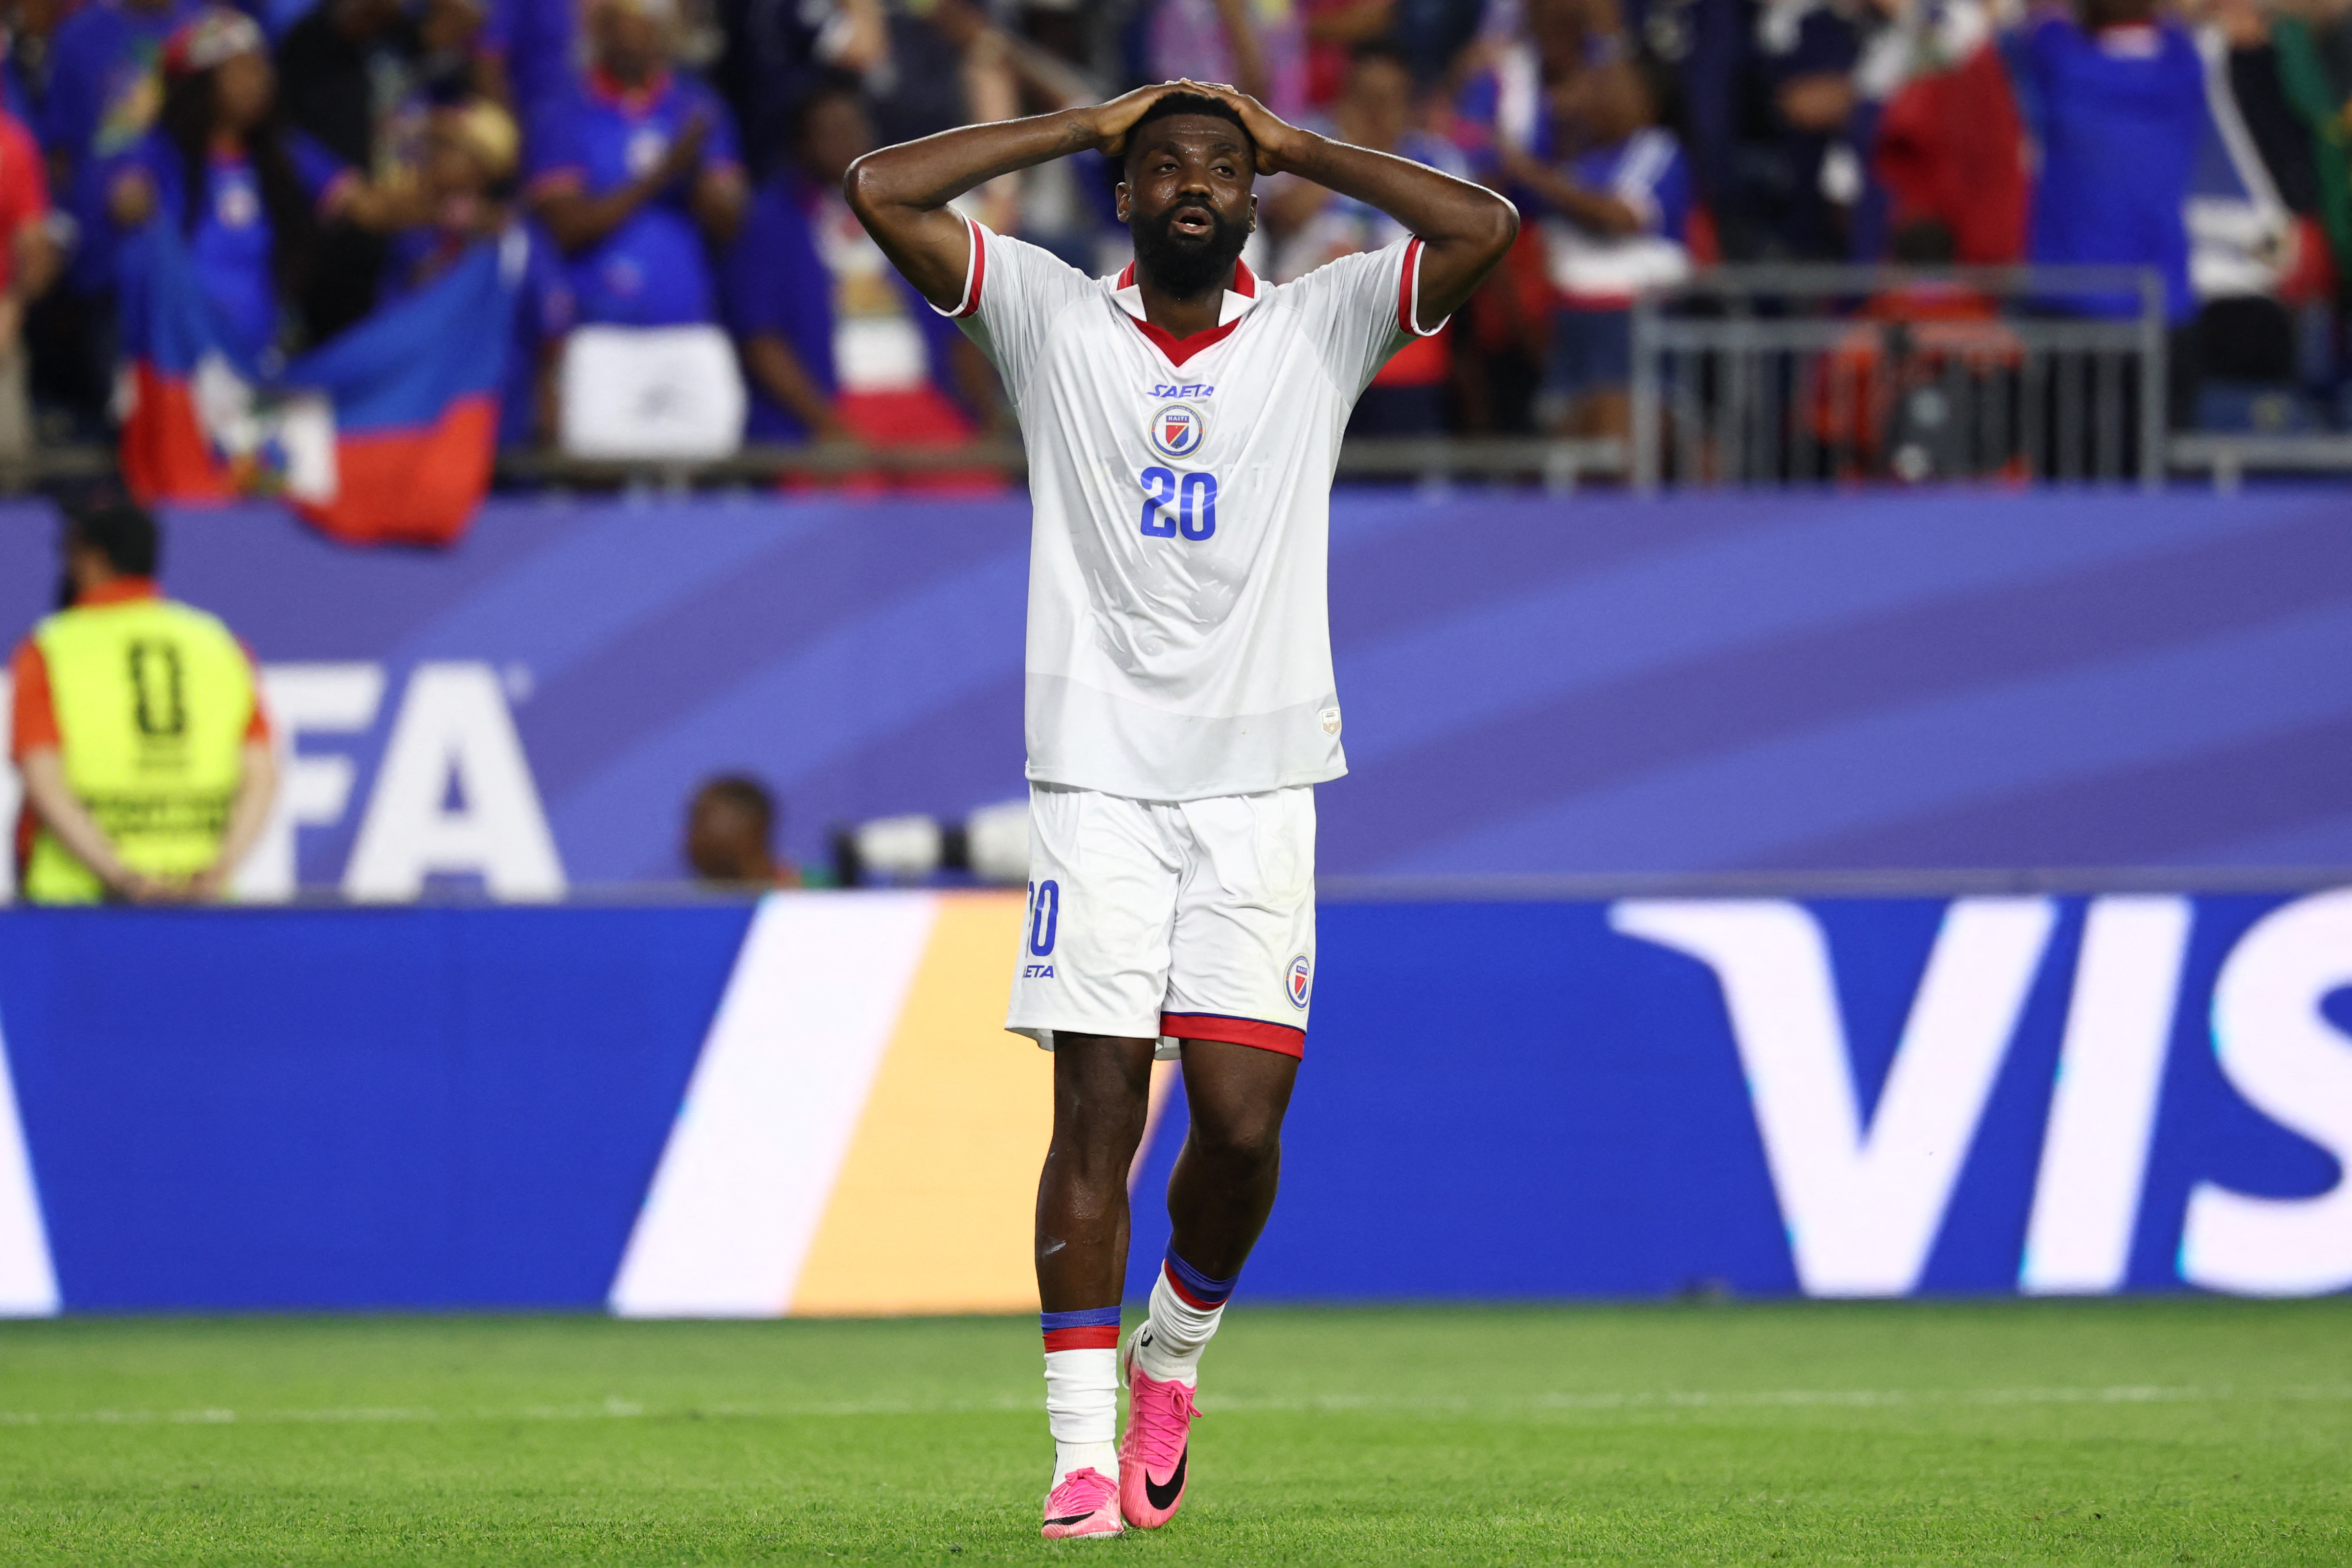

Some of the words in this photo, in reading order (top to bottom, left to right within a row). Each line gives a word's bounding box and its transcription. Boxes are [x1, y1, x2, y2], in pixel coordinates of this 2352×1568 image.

[1146, 384, 1214, 398] SAETA
[1140, 466, 1218, 541] 20
[0, 664, 565, 902] FA
[1026, 880, 1059, 957] 0
[1022, 965, 1054, 978] ETA
